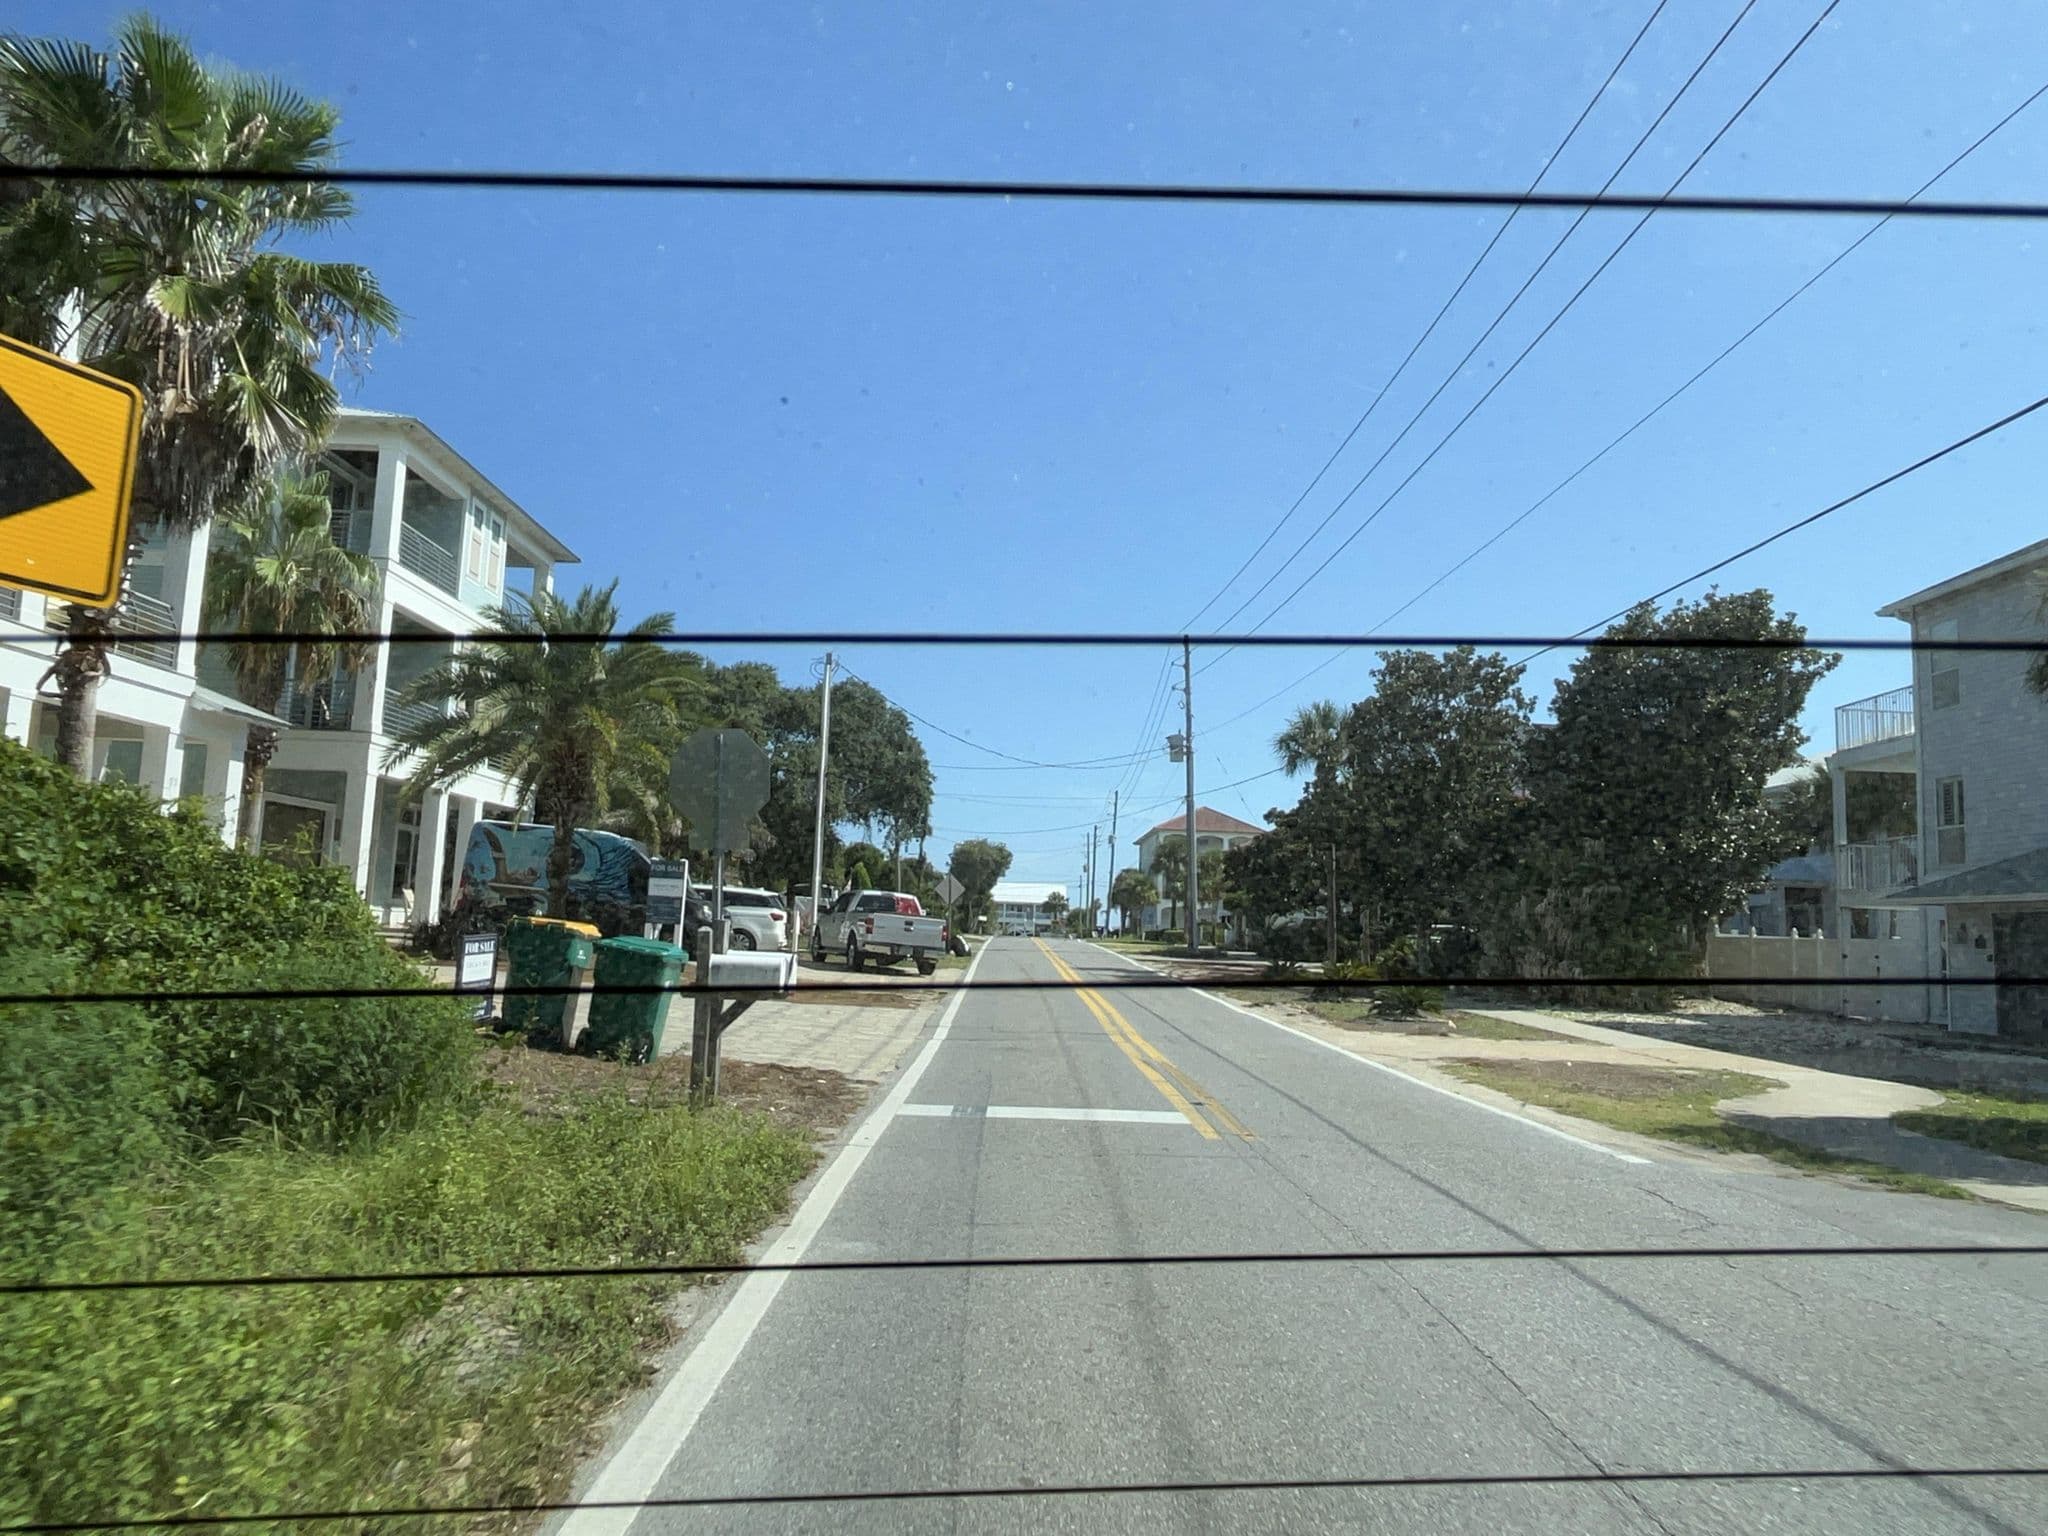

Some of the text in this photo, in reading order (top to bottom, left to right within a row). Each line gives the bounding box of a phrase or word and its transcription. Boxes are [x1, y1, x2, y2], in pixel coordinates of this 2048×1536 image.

[651, 864, 683, 872] FOR SALE
[465, 941, 495, 954] FOR SALE
